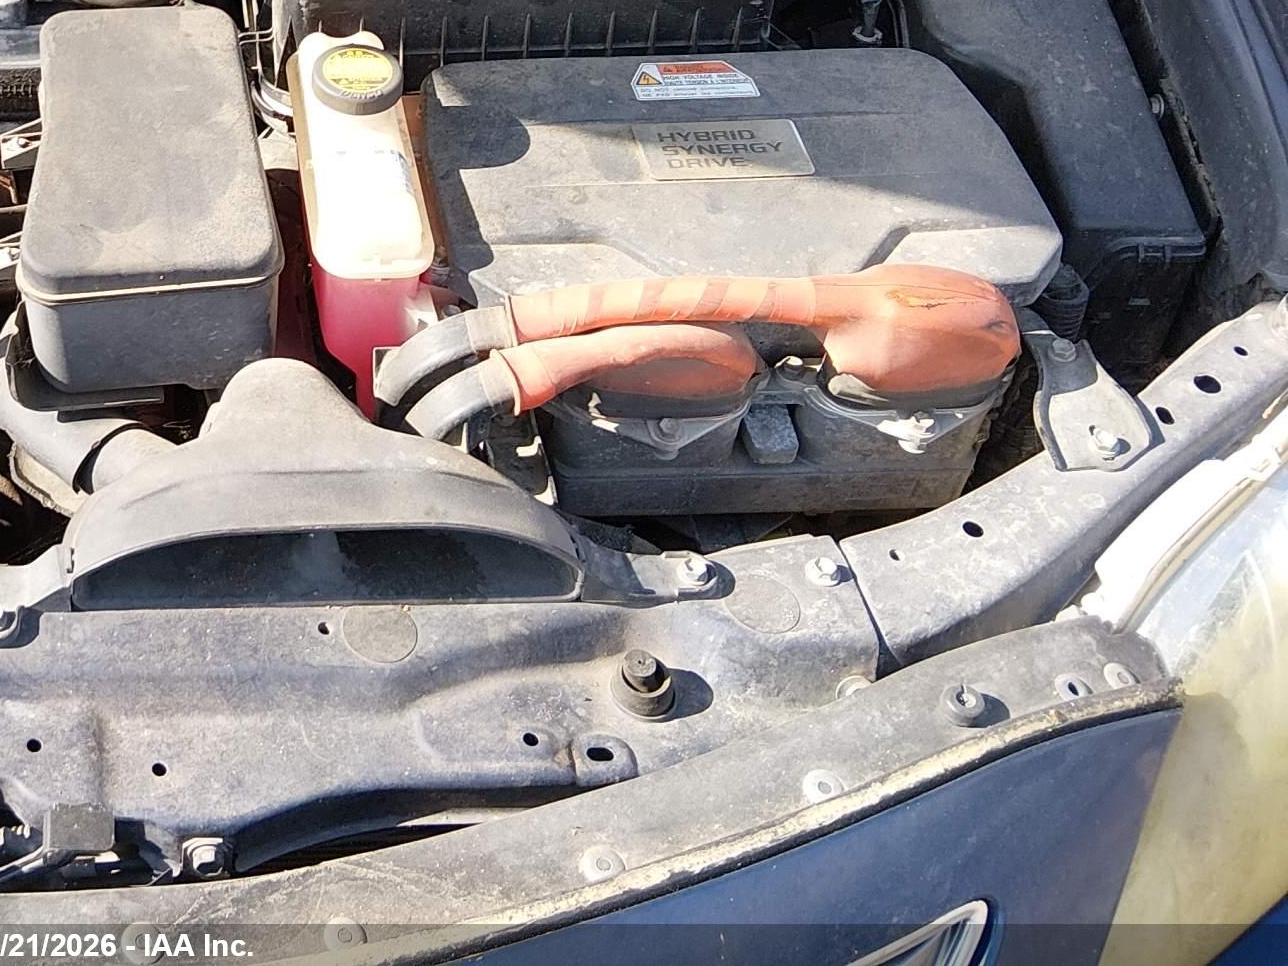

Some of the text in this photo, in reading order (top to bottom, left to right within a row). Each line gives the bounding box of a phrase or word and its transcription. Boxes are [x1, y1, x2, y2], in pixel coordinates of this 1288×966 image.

[656, 129, 756, 143] HYBRID
[662, 141, 784, 156] SYNERGY
[668, 156, 748, 170] DRIVE
